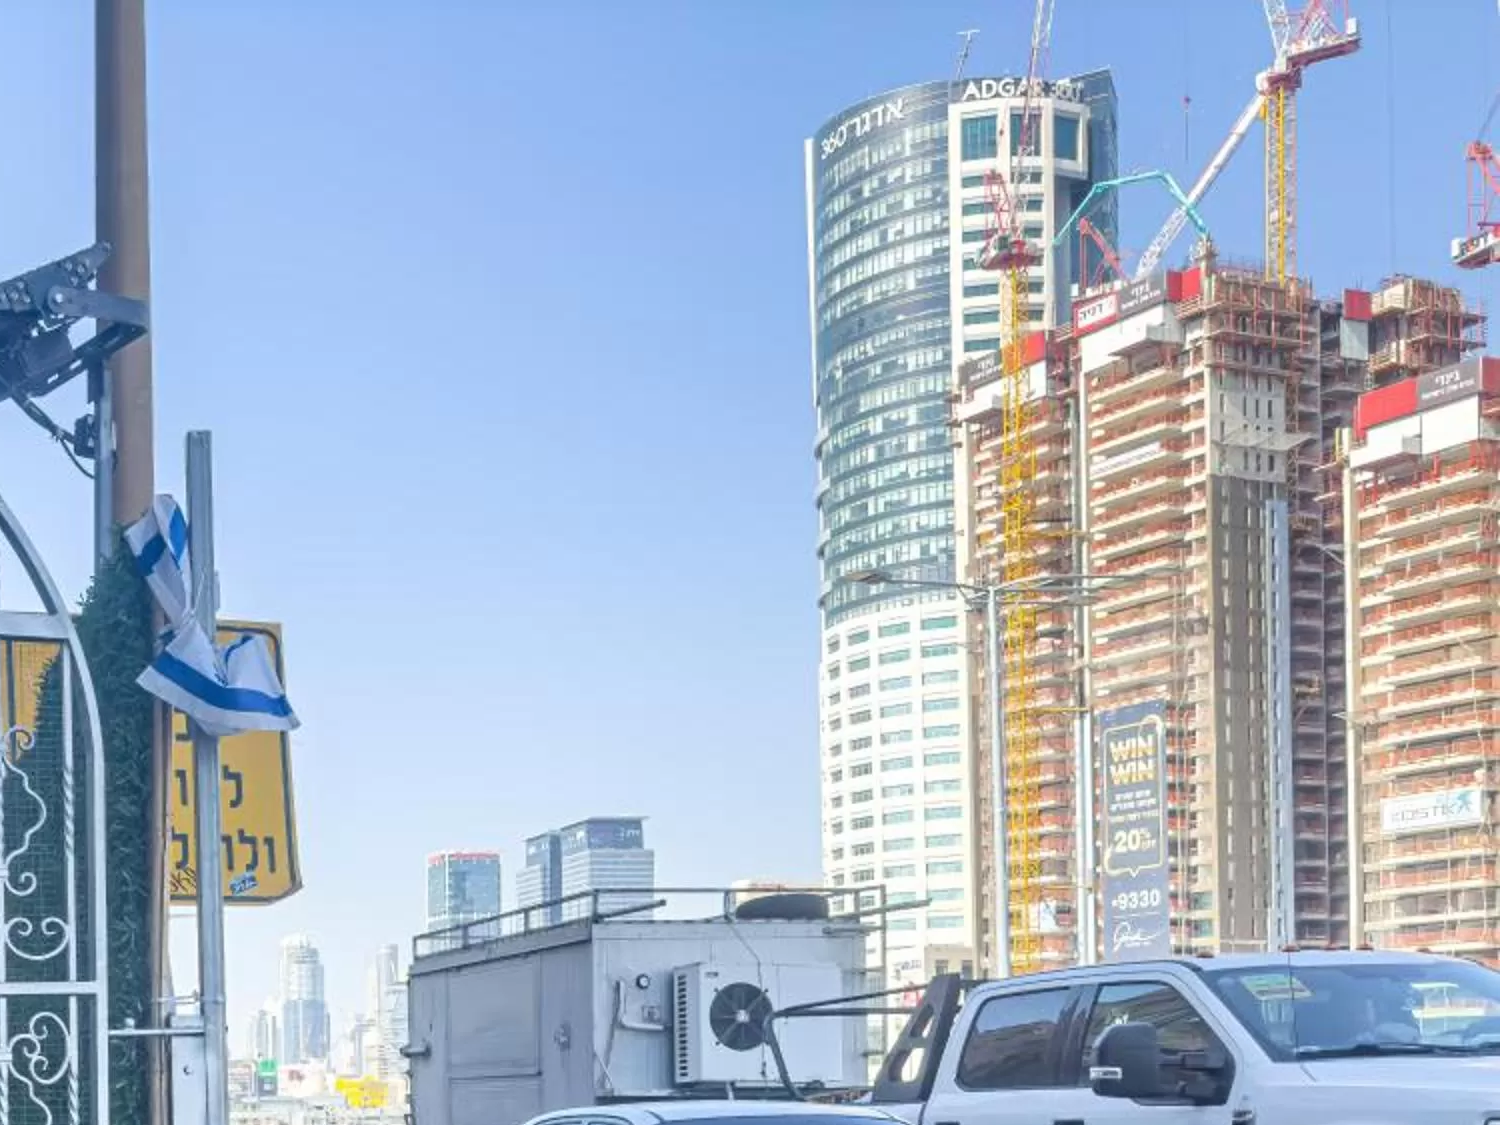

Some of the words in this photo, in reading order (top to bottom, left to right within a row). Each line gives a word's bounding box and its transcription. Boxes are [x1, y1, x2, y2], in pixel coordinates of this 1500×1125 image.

[962, 78, 1045, 101] ADGAR
[845, 97, 904, 137] אדגר
[1110, 734, 1155, 762] WIN
[1110, 758, 1155, 785] WIN
